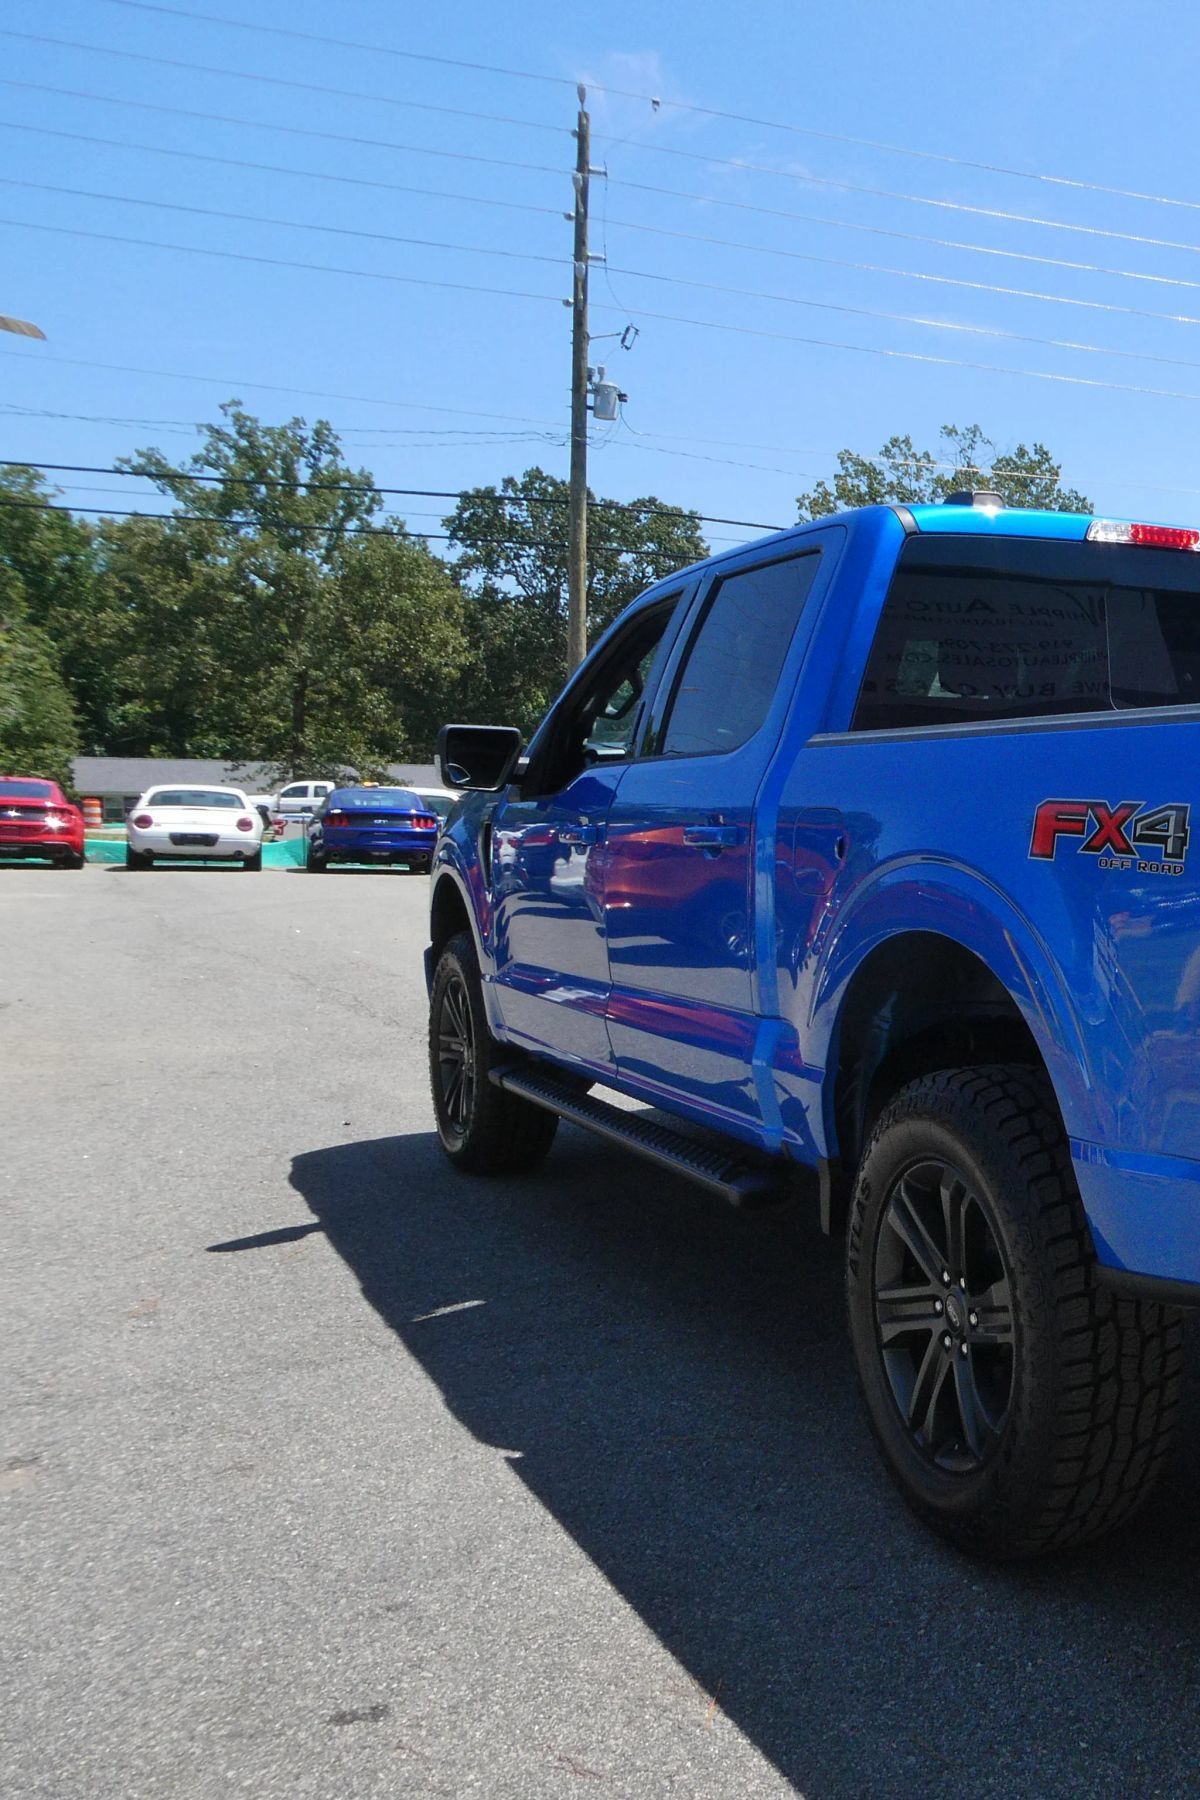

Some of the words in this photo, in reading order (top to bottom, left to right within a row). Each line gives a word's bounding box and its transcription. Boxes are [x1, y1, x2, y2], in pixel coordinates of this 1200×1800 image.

[1028, 798, 1190, 861] FX4
[1098, 857, 1132, 870] OFF
[1137, 861, 1185, 876] ROAD
